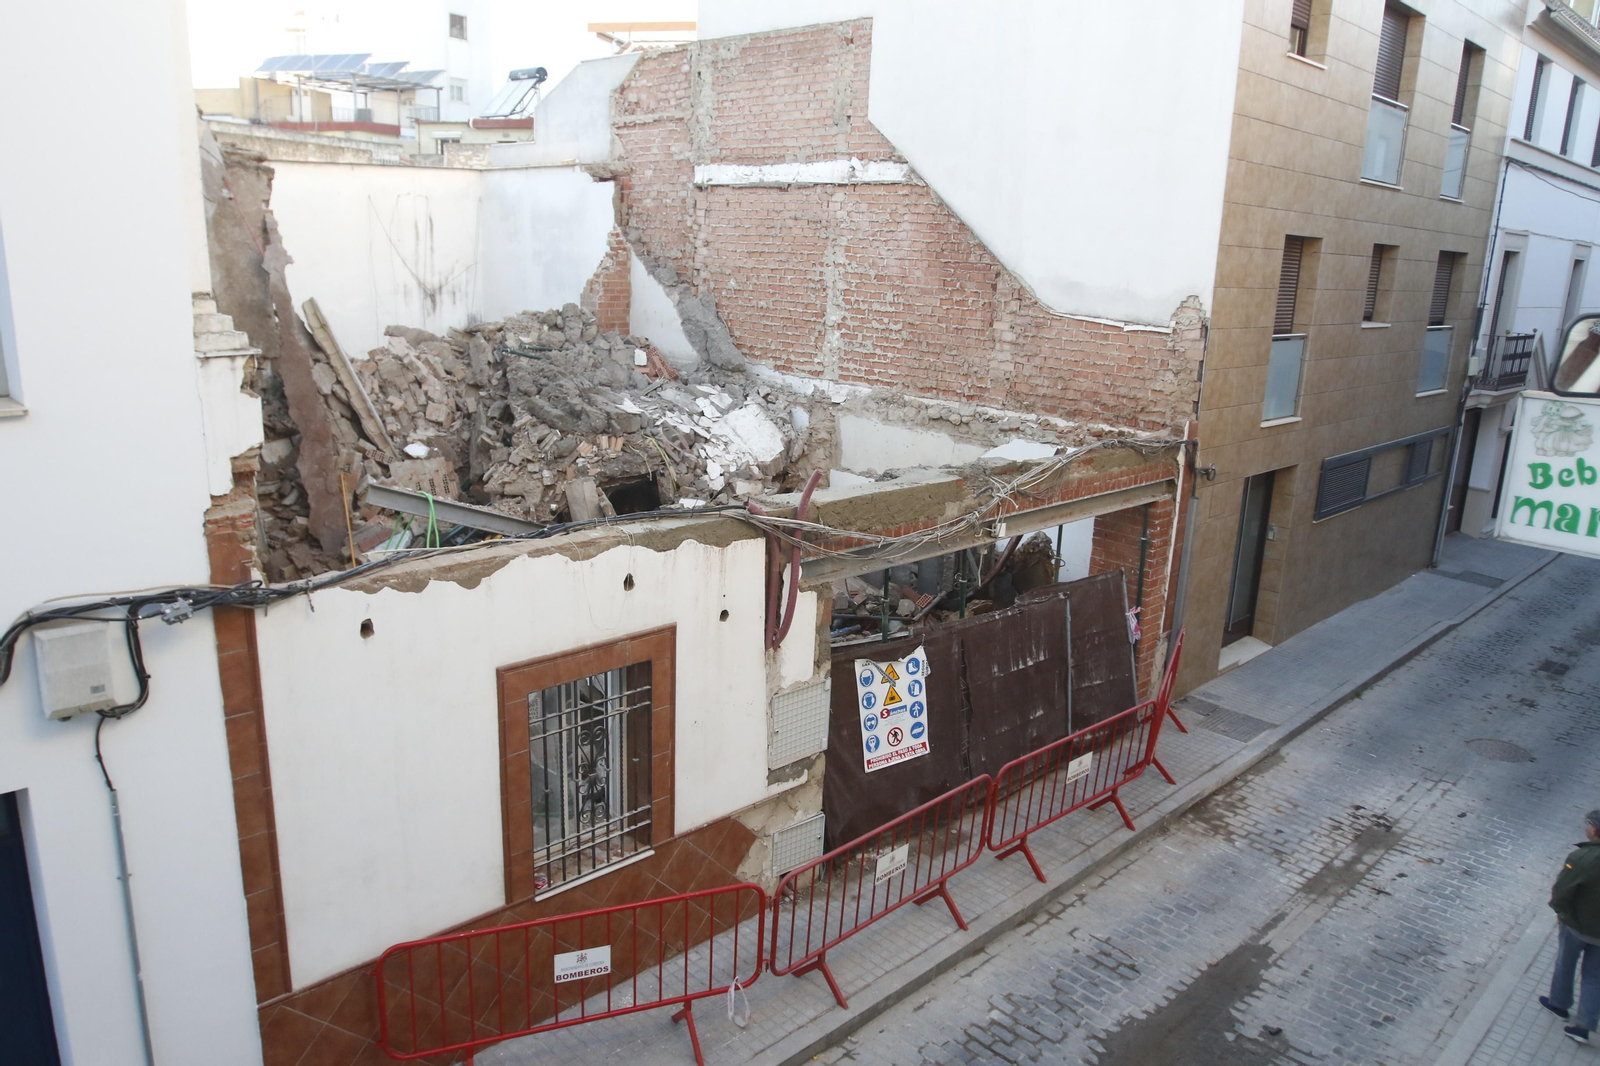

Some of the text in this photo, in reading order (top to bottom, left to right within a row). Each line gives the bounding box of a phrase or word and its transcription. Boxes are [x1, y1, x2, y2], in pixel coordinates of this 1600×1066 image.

[1527, 457, 1597, 489] Beb
[869, 759, 888, 769] PERSONA
[888, 755, 901, 763] AJENA
[870, 752, 892, 763] PROHIBIDO
[876, 862, 906, 882] BOMBEROS
[556, 966, 609, 981] BOMBEROS
